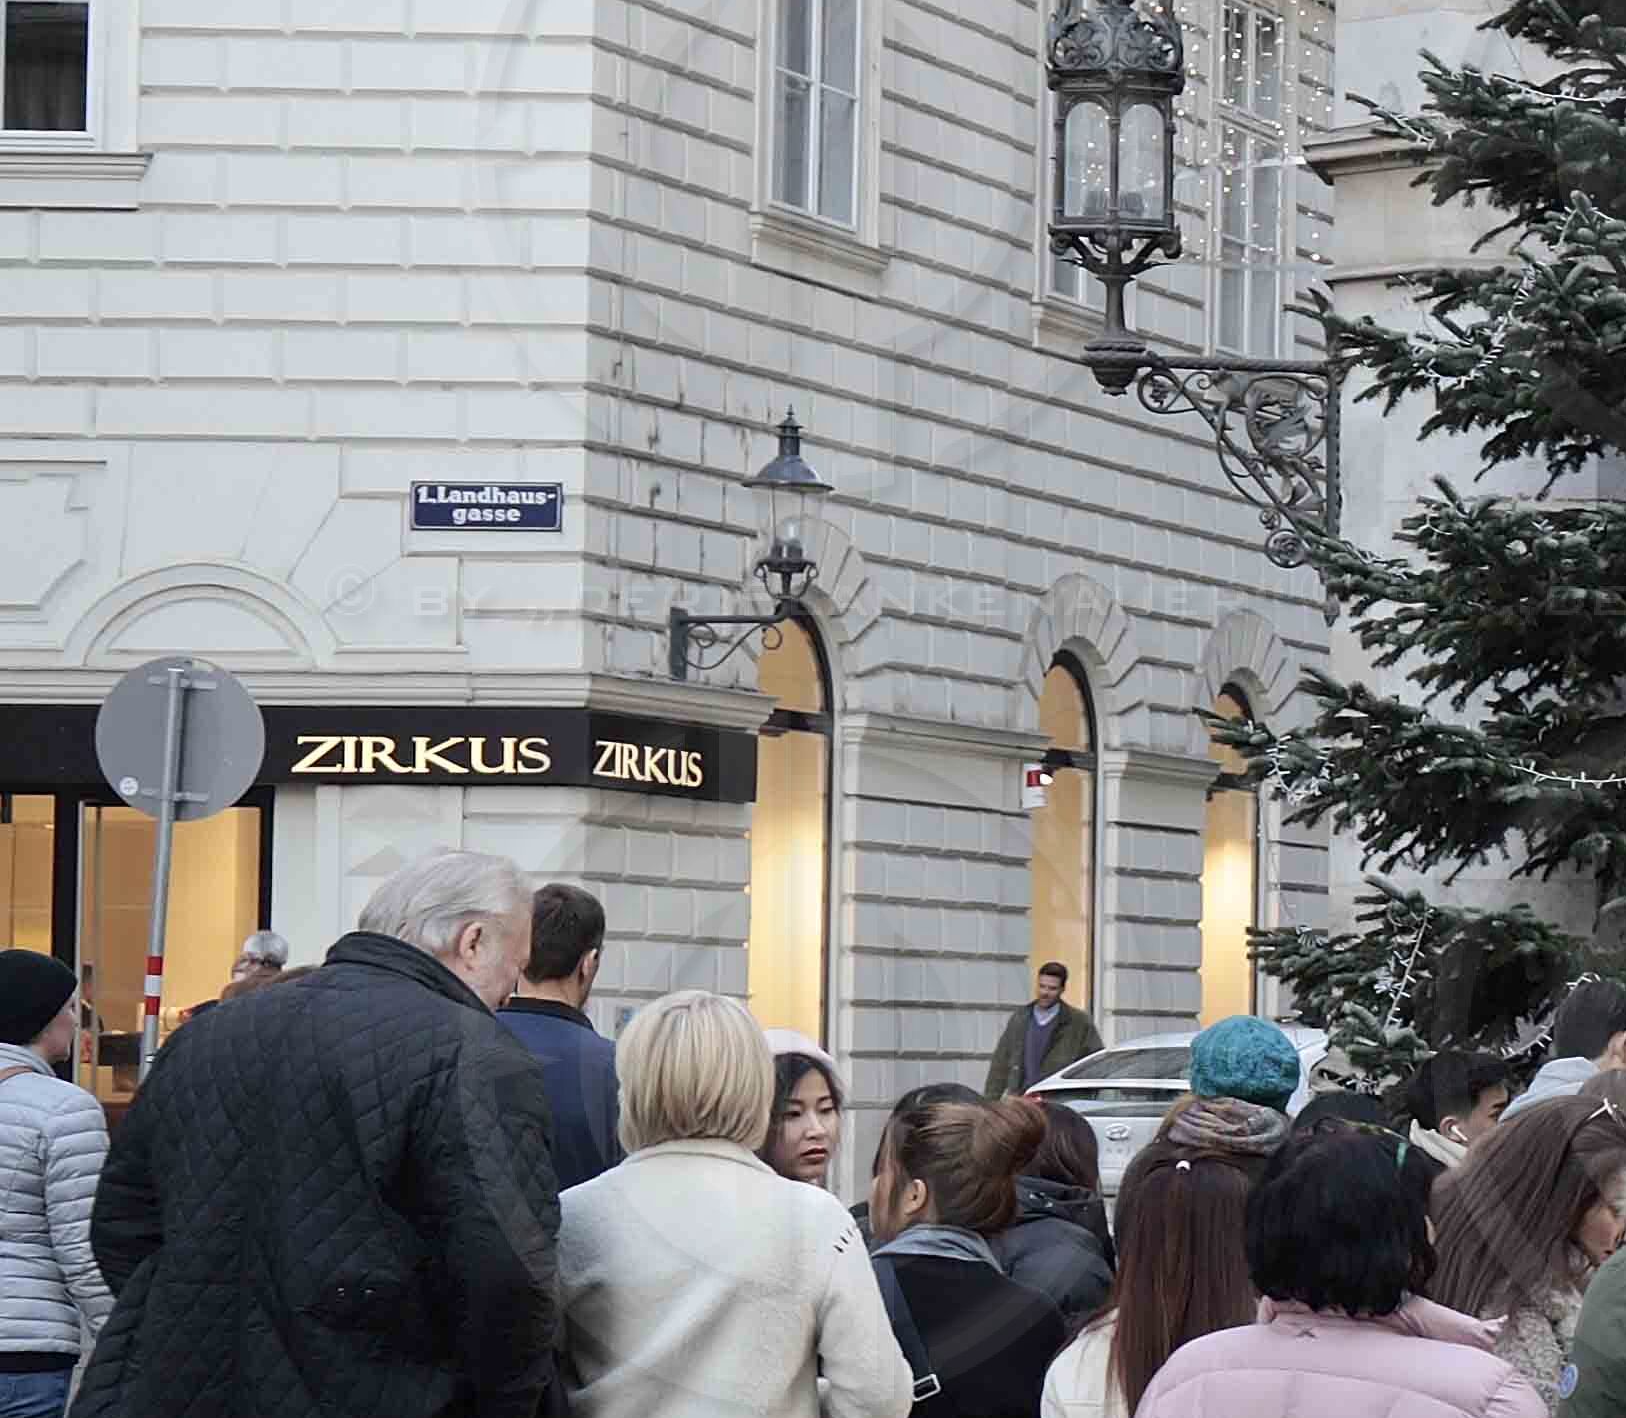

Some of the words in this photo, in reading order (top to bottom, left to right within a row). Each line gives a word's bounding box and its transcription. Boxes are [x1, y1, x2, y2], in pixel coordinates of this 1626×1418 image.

[452, 508, 521, 525] gasse
[291, 736, 551, 774] ZIRKUS
[592, 740, 703, 787] ZIRKUS
